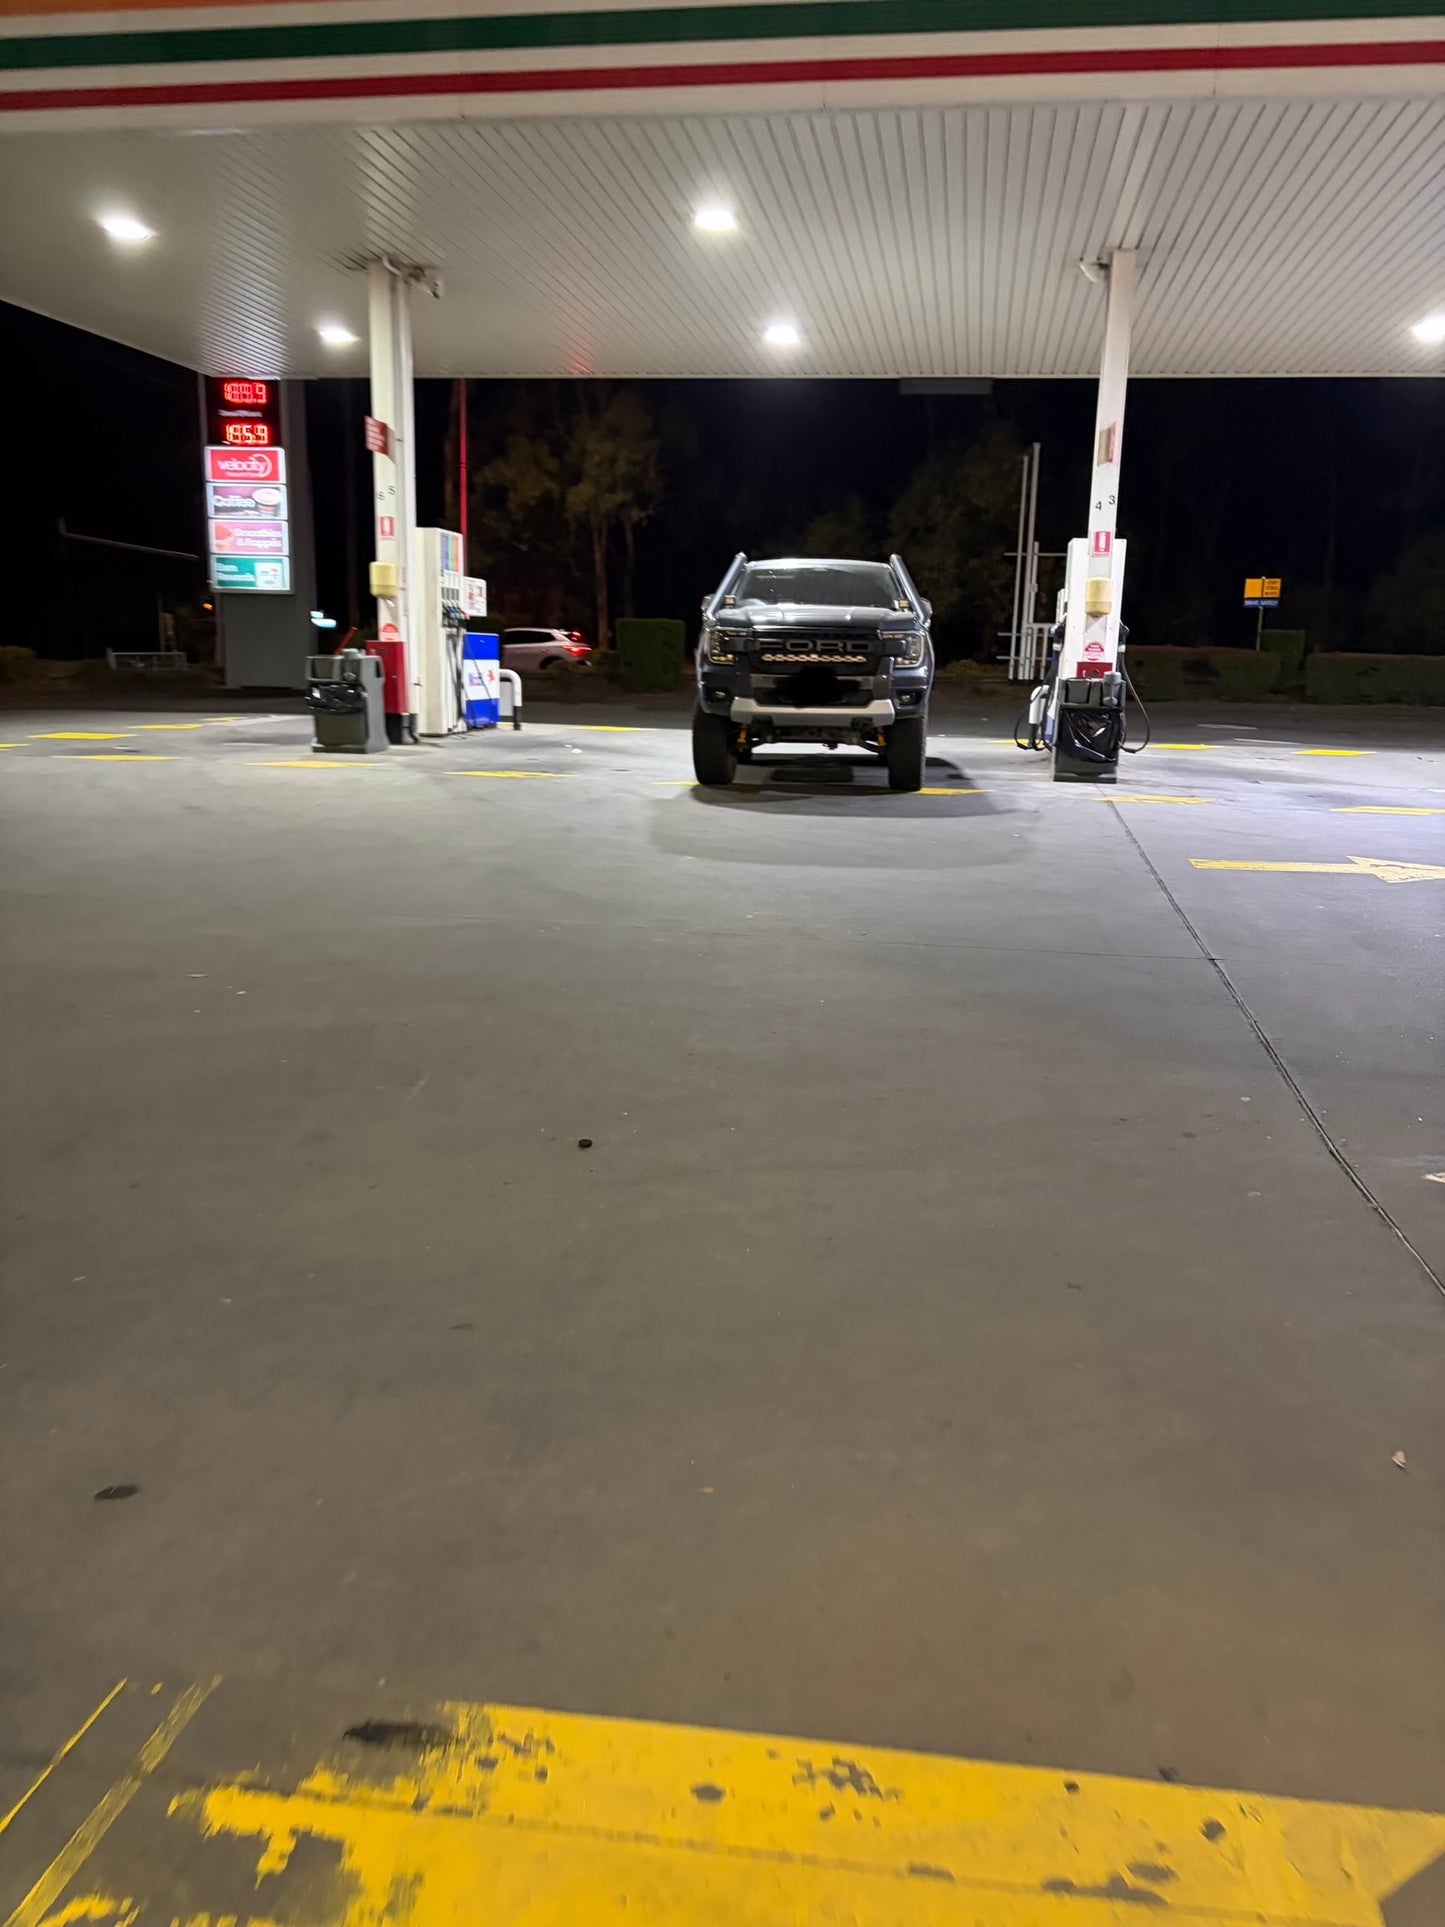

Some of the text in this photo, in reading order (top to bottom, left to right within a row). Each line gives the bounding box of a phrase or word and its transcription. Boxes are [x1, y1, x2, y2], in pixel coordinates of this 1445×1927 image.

[1095, 495, 1116, 511] 4 3
[756, 638, 872, 652] FORD
